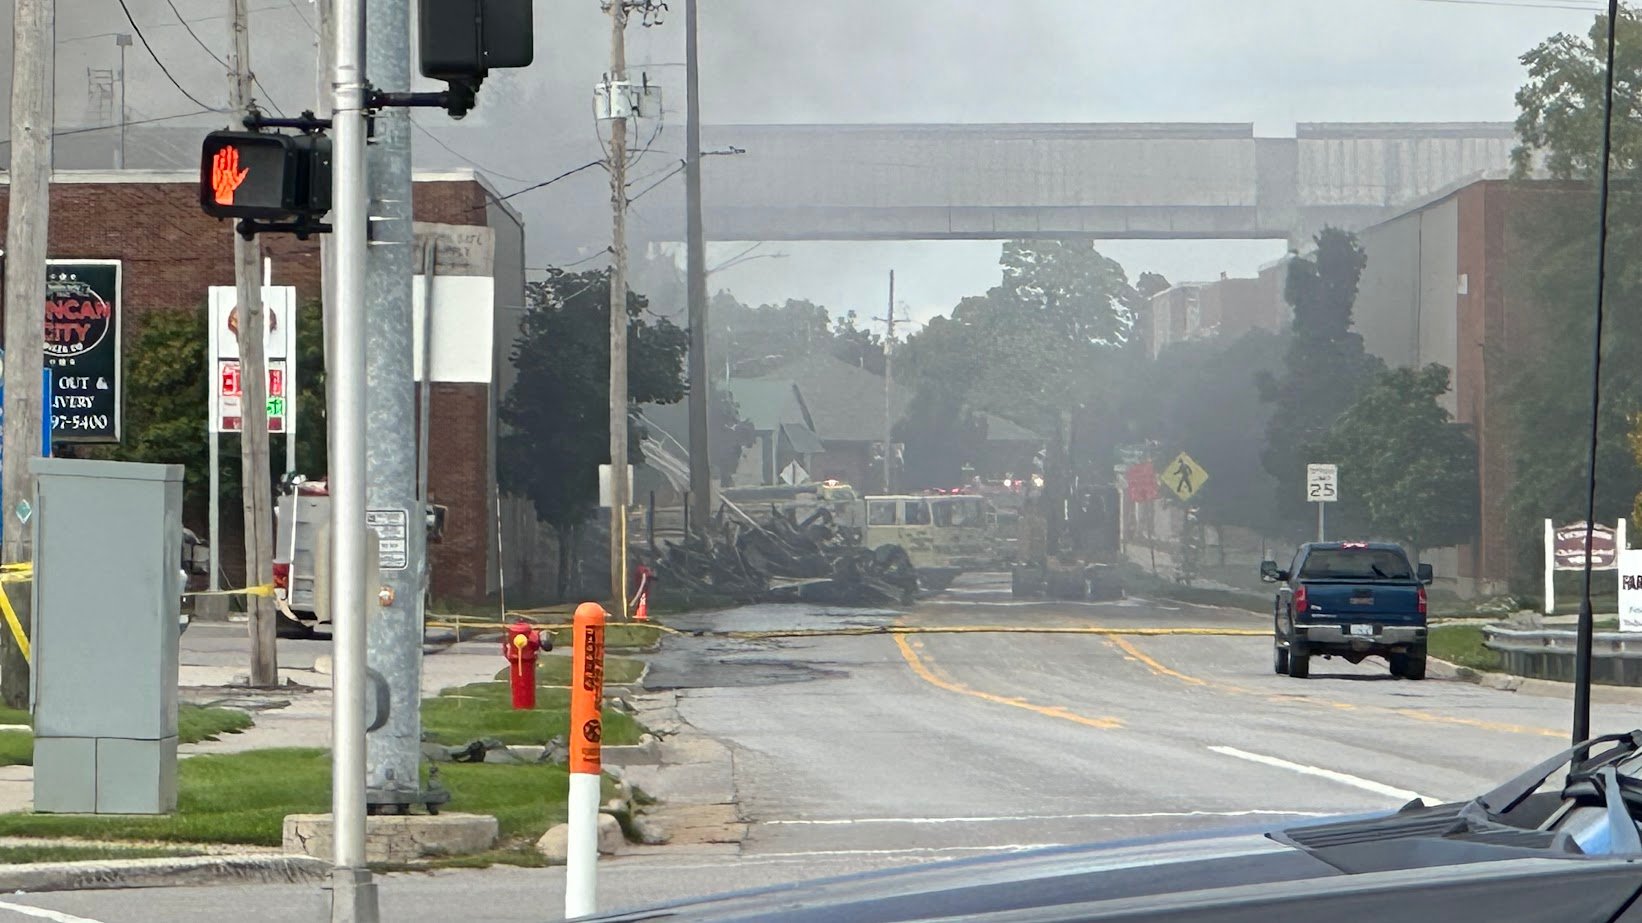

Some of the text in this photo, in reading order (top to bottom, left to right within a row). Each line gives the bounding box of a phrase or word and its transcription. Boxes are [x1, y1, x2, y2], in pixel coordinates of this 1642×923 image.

[46, 299, 110, 320] NCAN
[58, 376, 90, 390] OUT
[52, 395, 95, 409] IVERY
[51, 414, 108, 430] 97-5400
[1310, 483, 1336, 497] 25
